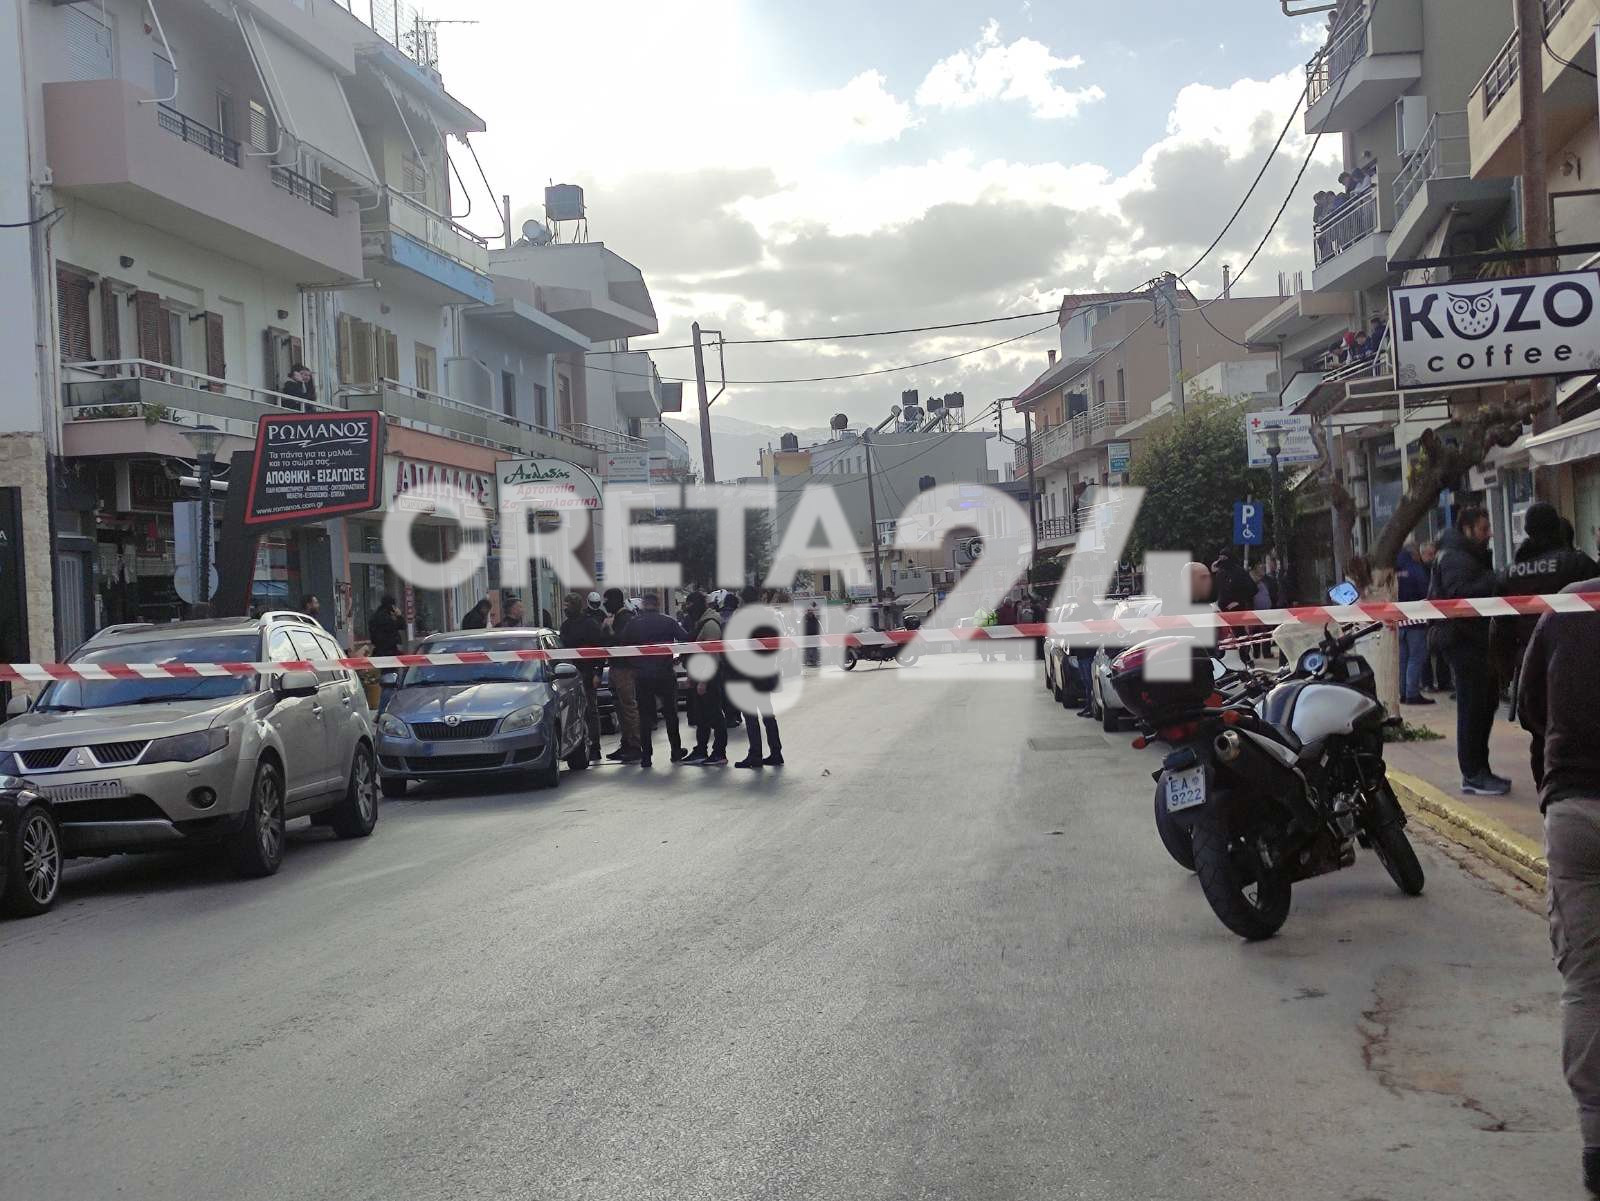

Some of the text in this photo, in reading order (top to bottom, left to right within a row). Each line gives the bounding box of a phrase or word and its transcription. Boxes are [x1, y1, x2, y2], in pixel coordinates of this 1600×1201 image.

[1427, 343, 1573, 373] coffee
[268, 422, 368, 440] ΡΩΜΑΝΟΣ
[280, 450, 303, 458] πάντα
[304, 451, 316, 459] για
[265, 470, 310, 484] ΑΠΟΘΗΚΗ
[317, 467, 365, 483] ΕΙΣΑΓΩΓΕΣ
[1242, 505, 1255, 524] P
[1509, 560, 1557, 577] POLICE
[1172, 788, 1201, 806] 9222
